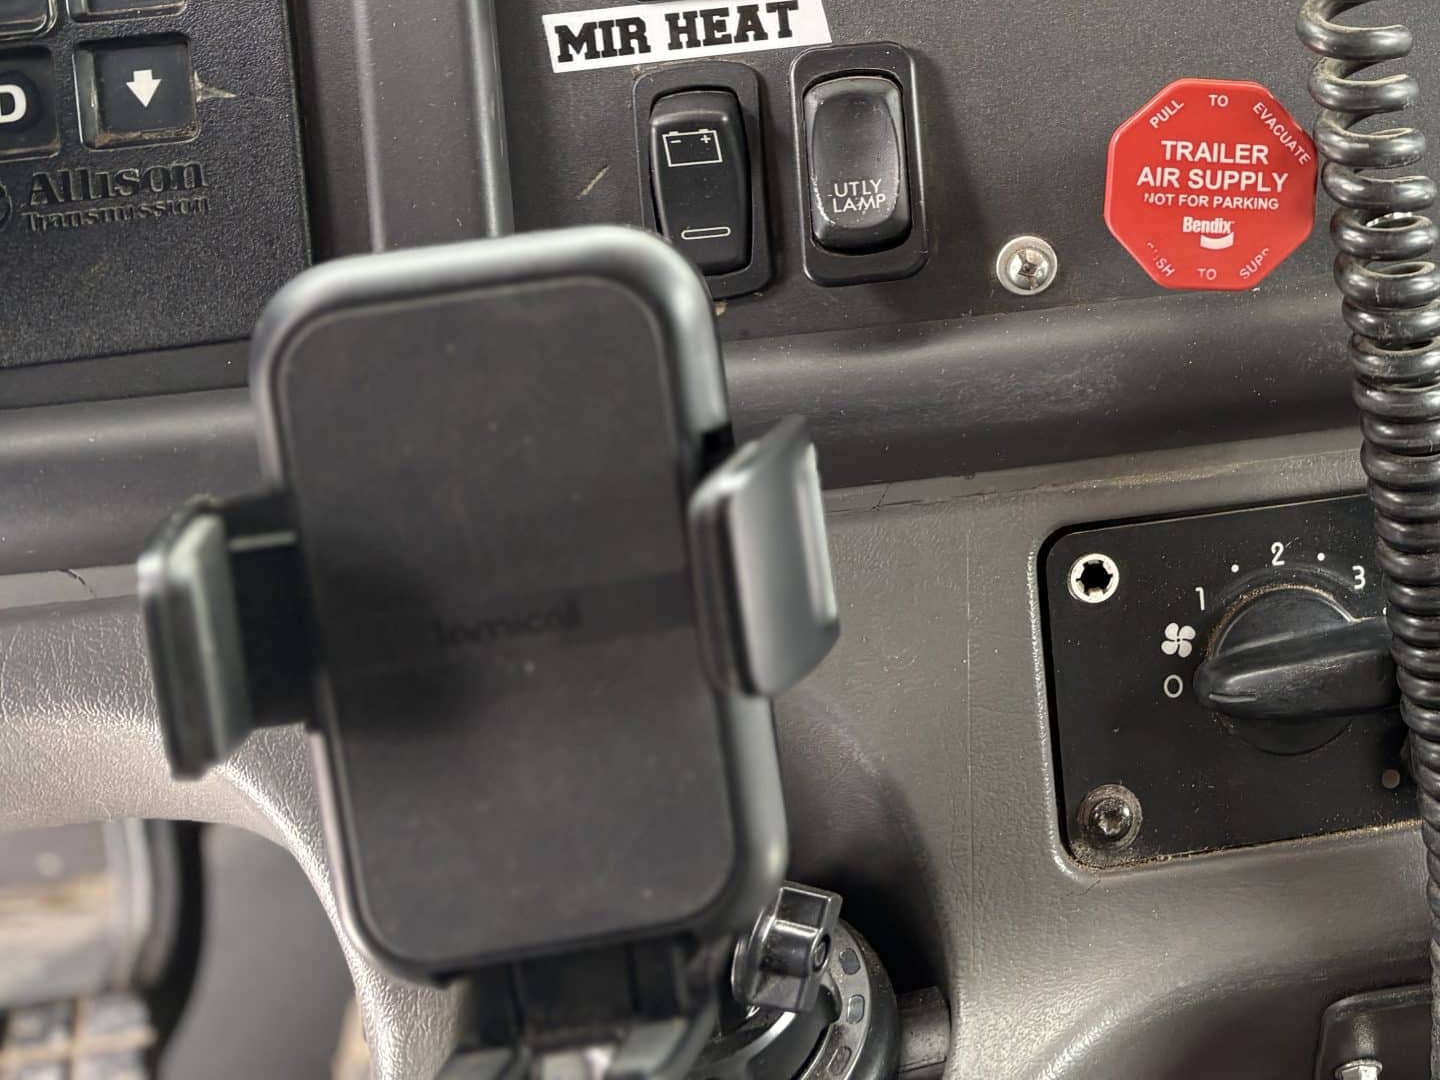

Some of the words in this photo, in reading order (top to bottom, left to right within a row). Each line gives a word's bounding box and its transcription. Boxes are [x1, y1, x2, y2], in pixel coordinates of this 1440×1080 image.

[554, 17, 651, 63] MIR
[664, 0, 799, 51] HEAT
[1149, 99, 1185, 128] PULL
[1208, 94, 1229, 108] TO
[1252, 102, 1312, 165] EVACUATE
[1161, 140, 1269, 166] TRAILER
[30, 161, 209, 206] Allison
[833, 178, 882, 198] UTLY
[1136, 167, 1180, 188] AIR
[1187, 169, 1289, 193] SUPPLY
[832, 193, 887, 213] LAMP
[1143, 193, 1176, 206] NOT
[1178, 194, 1209, 208] FOR
[1213, 196, 1279, 210] PARKING
[20, 196, 210, 232] Transmission
[1182, 216, 1232, 234] Bendix
[1197, 268, 1217, 281] TO
[1270, 542, 1286, 566] 2
[1352, 565, 1366, 590] 3
[1195, 587, 1206, 611] 1
